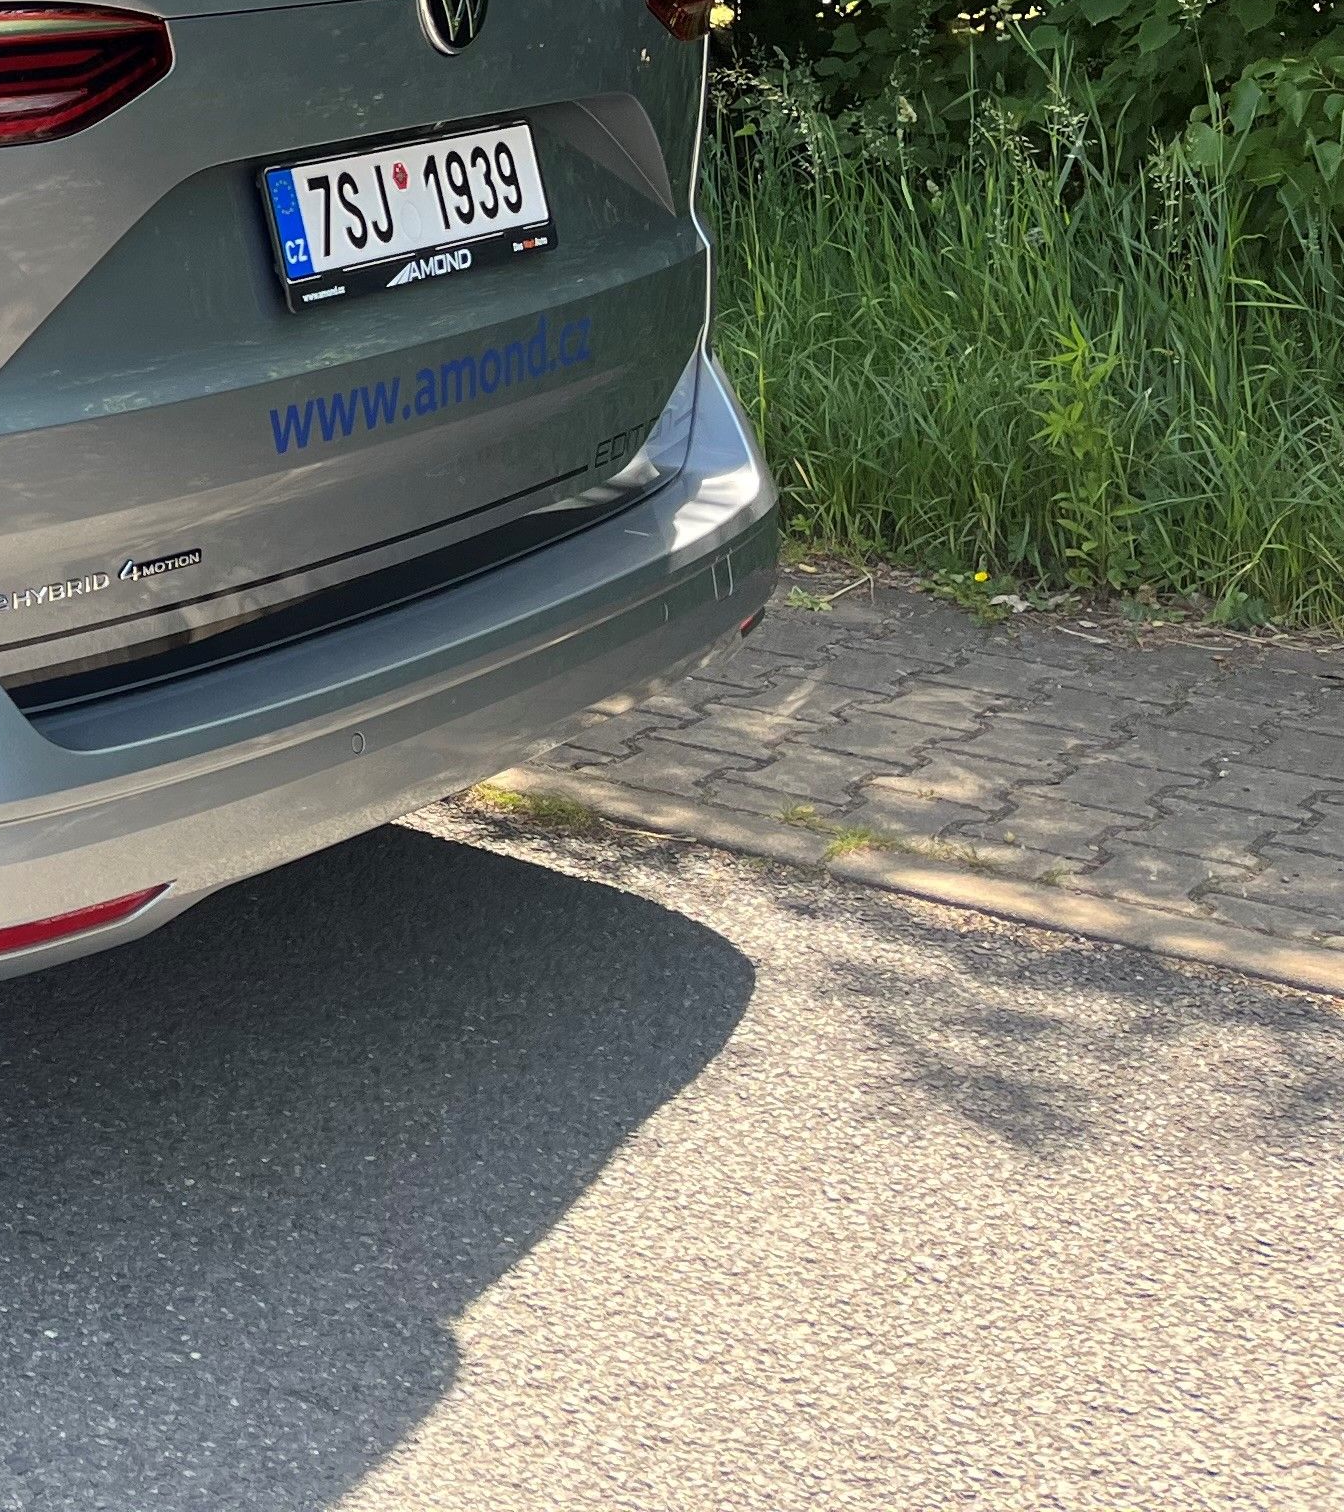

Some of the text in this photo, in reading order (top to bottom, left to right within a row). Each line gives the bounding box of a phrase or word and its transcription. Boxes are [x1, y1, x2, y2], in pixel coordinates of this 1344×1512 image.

[306, 141, 523, 257] 7SJ 1939
[285, 237, 309, 266] CZ
[409, 248, 472, 282] AMOND
[269, 312, 592, 455] www.amond.cz
[117, 551, 200, 582] 4MOTION
